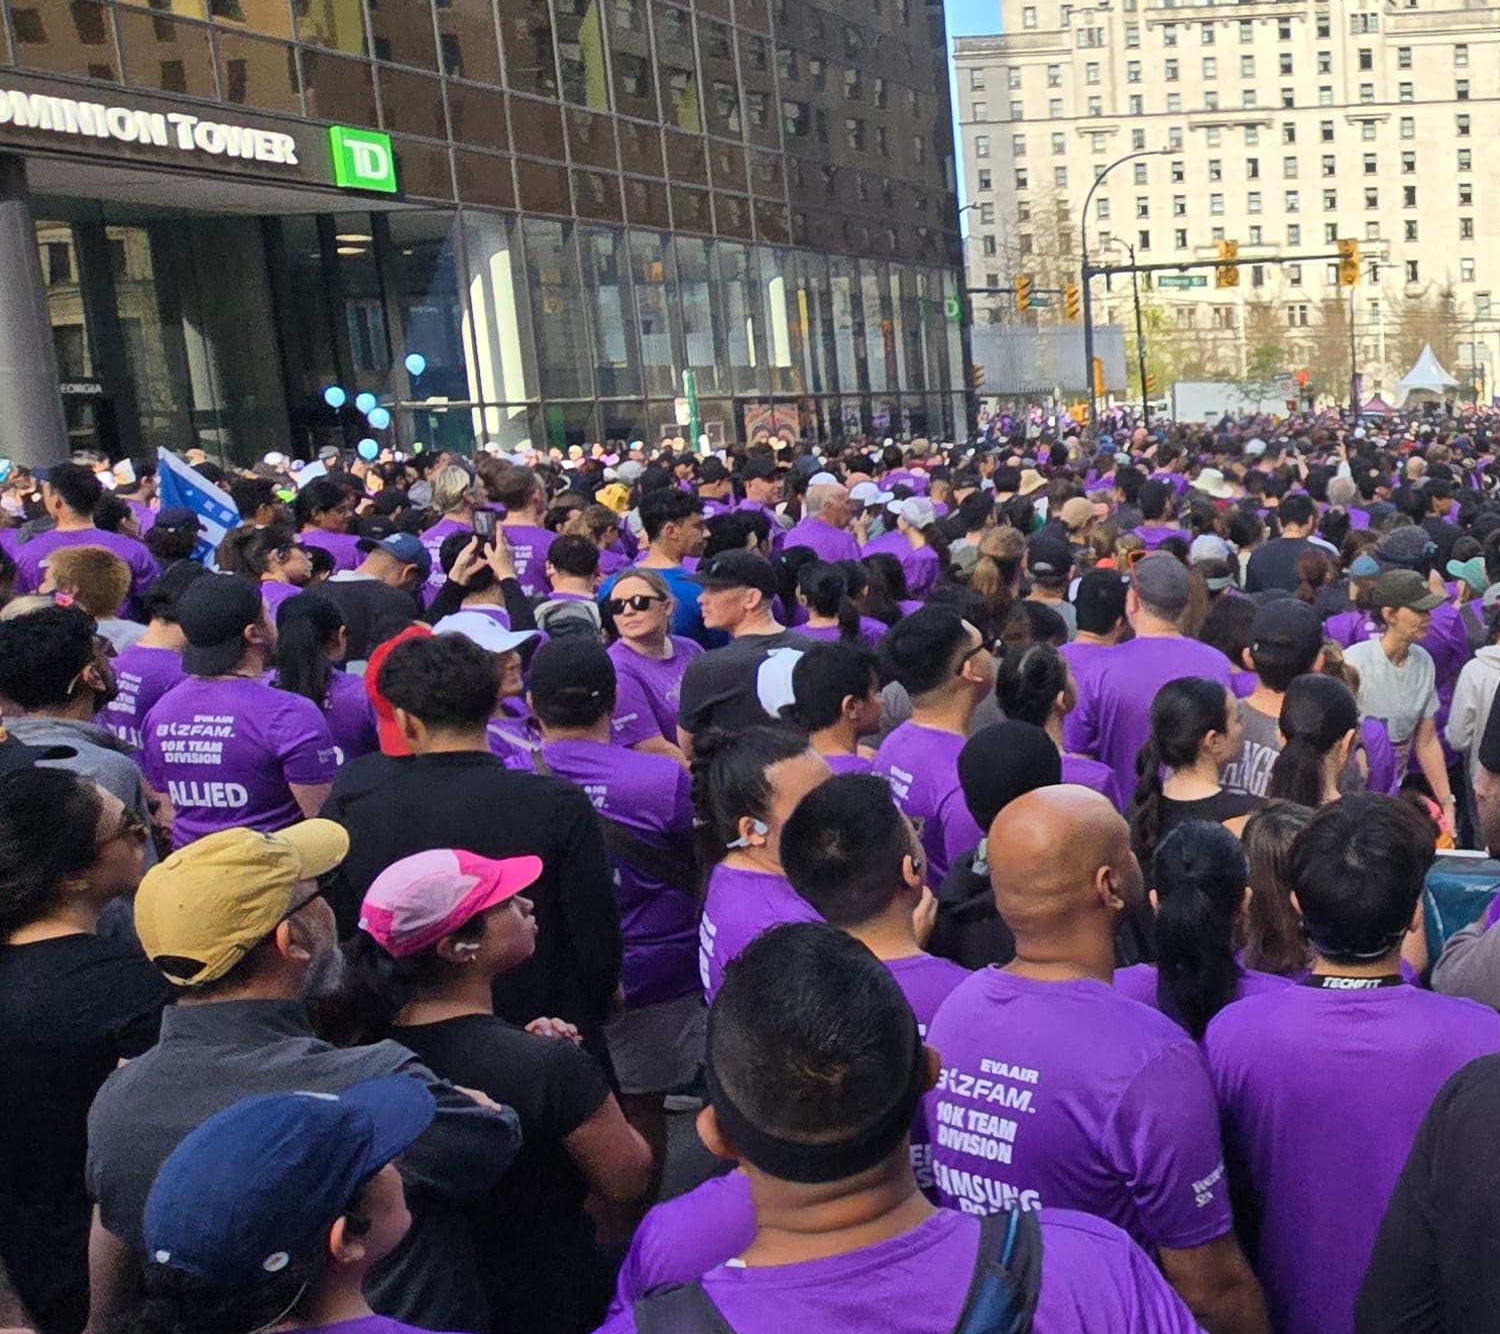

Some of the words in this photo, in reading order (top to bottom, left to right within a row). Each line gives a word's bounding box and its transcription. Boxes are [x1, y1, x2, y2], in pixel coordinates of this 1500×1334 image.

[168, 113, 298, 165] TOWER
[343, 139, 389, 180] TD
[161, 740, 185, 752] 10K
[188, 740, 223, 753] TEAM
[164, 752, 222, 765] DIVISION
[168, 780, 249, 809] ALLIED
[937, 1101, 966, 1128] 10K
[967, 1109, 1018, 1143] TEAM
[937, 1124, 1013, 1165] DIVISION
